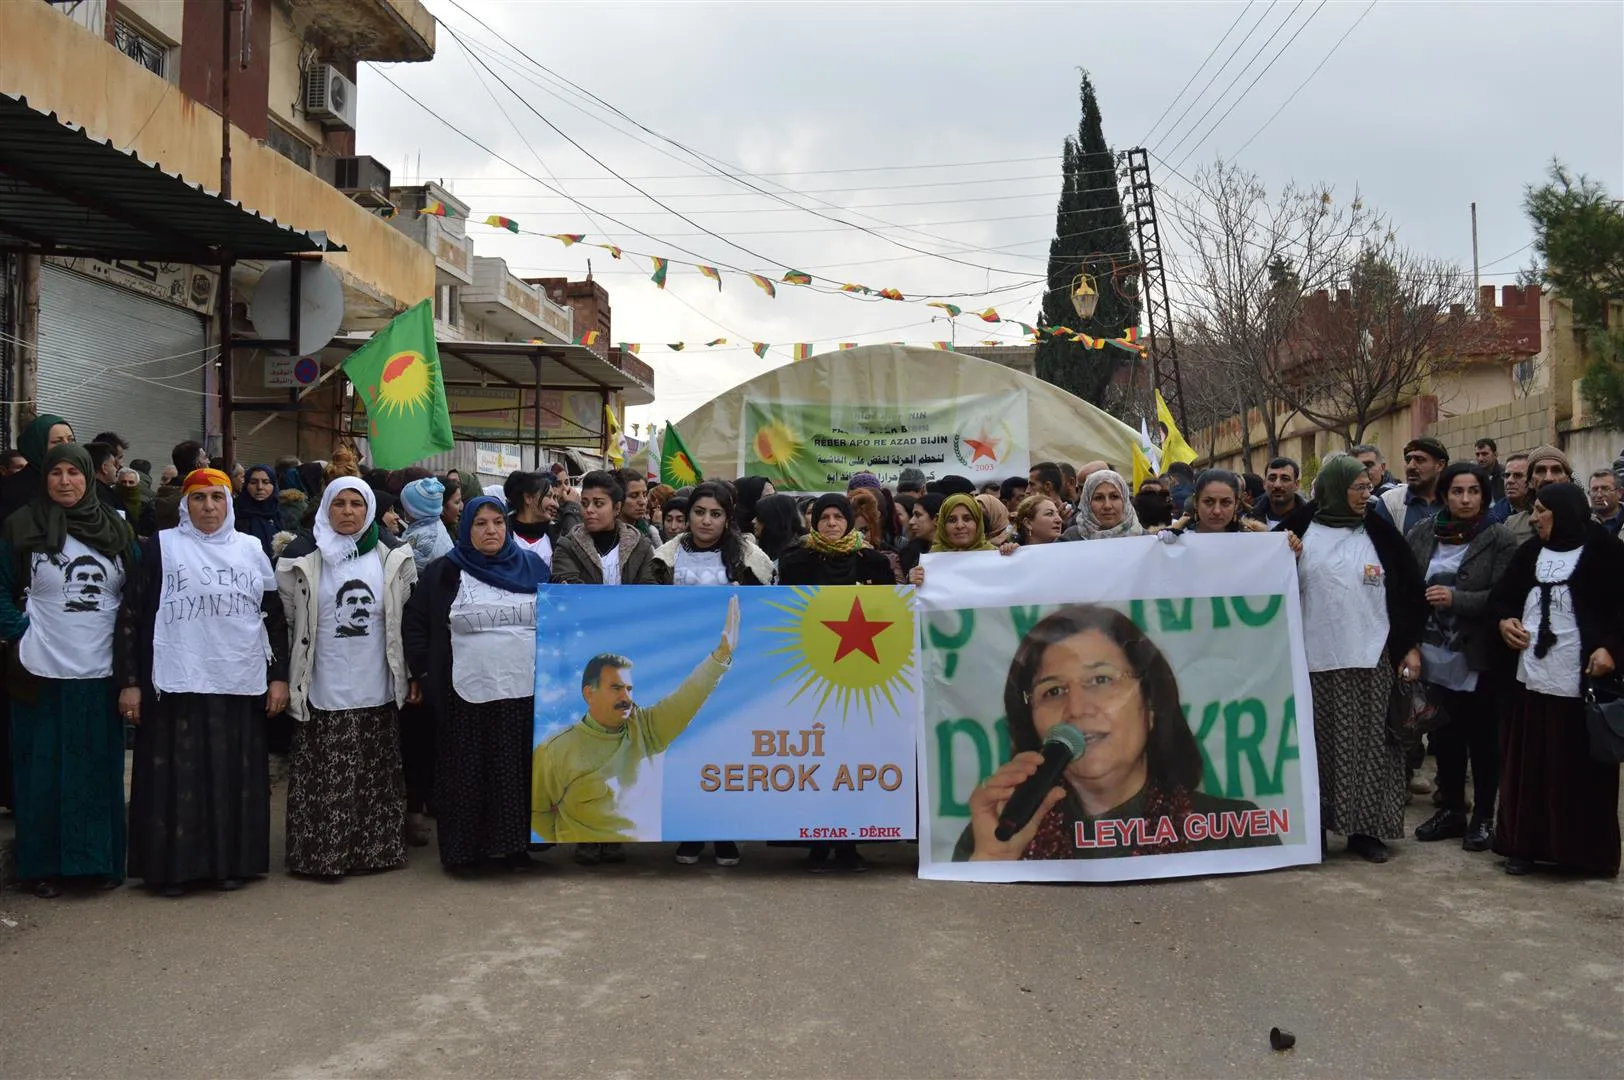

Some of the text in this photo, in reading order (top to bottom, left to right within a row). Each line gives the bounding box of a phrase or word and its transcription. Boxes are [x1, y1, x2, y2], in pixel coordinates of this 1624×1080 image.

[849, 439, 870, 447] APO
[889, 437, 917, 446] AZAD
[920, 435, 948, 445] BIJIN
[752, 722, 826, 757] BIJÎ
[700, 763, 903, 792] SEROK APO
[799, 828, 848, 839] K.STAR
[859, 825, 902, 838] DÊRIK
[1075, 808, 1290, 848] LEYLA GUVEN
